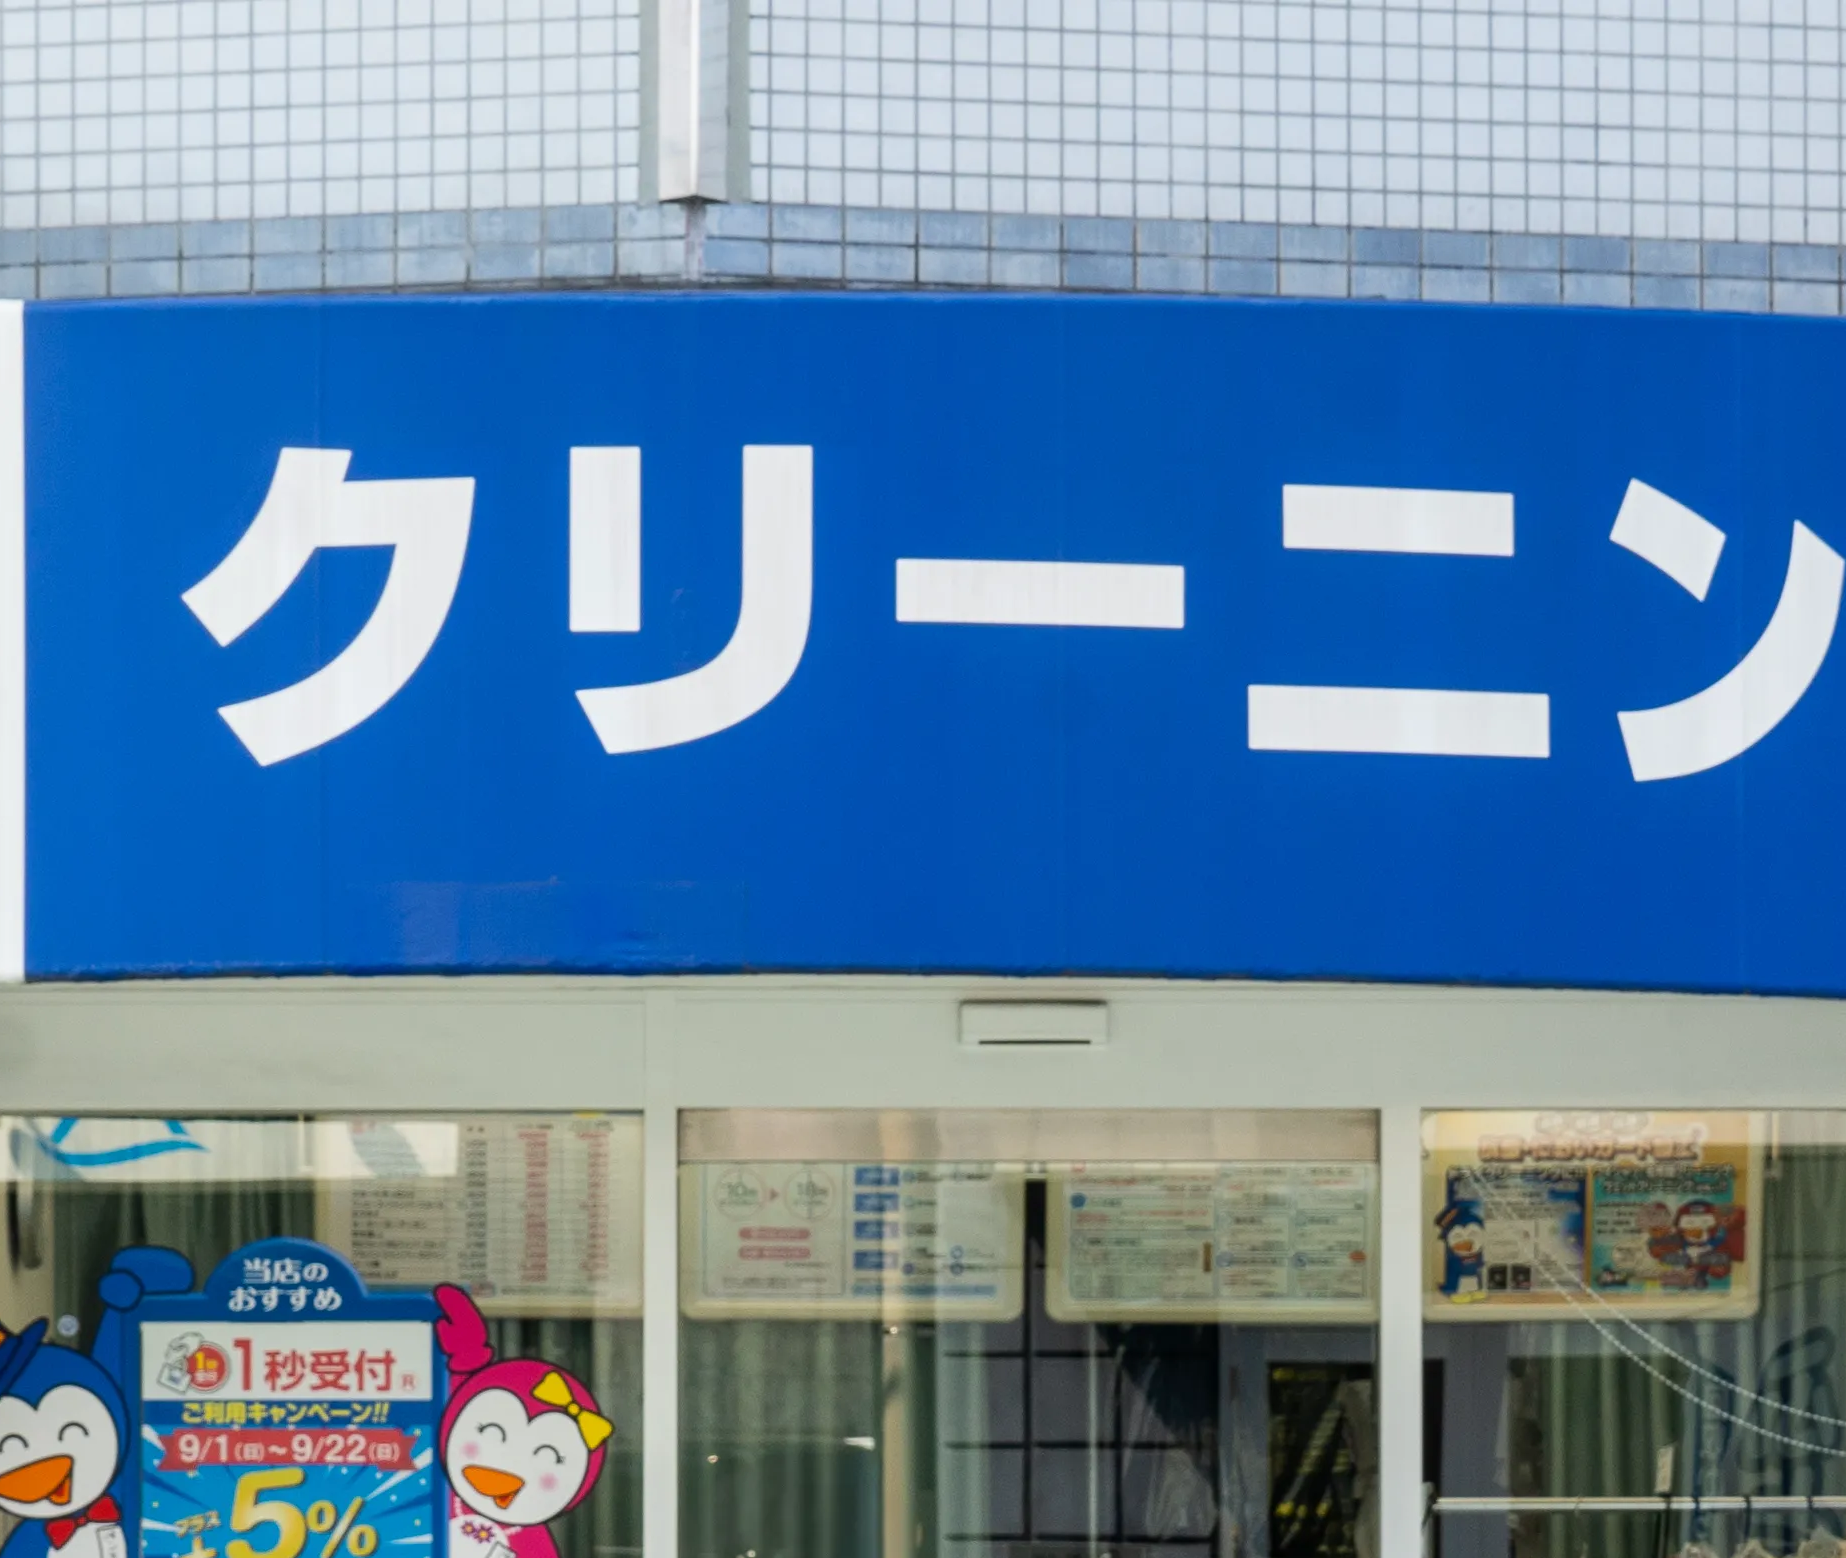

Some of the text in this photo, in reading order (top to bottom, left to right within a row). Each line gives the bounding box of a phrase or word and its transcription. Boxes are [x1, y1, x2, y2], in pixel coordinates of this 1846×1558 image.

[243, 1257, 330, 1284] 当店の
[228, 1286, 343, 1312] おすすめ
[234, 1338, 396, 1392] 1秒受付
[181, 1402, 391, 1425] ご利用キャンペーン!!
